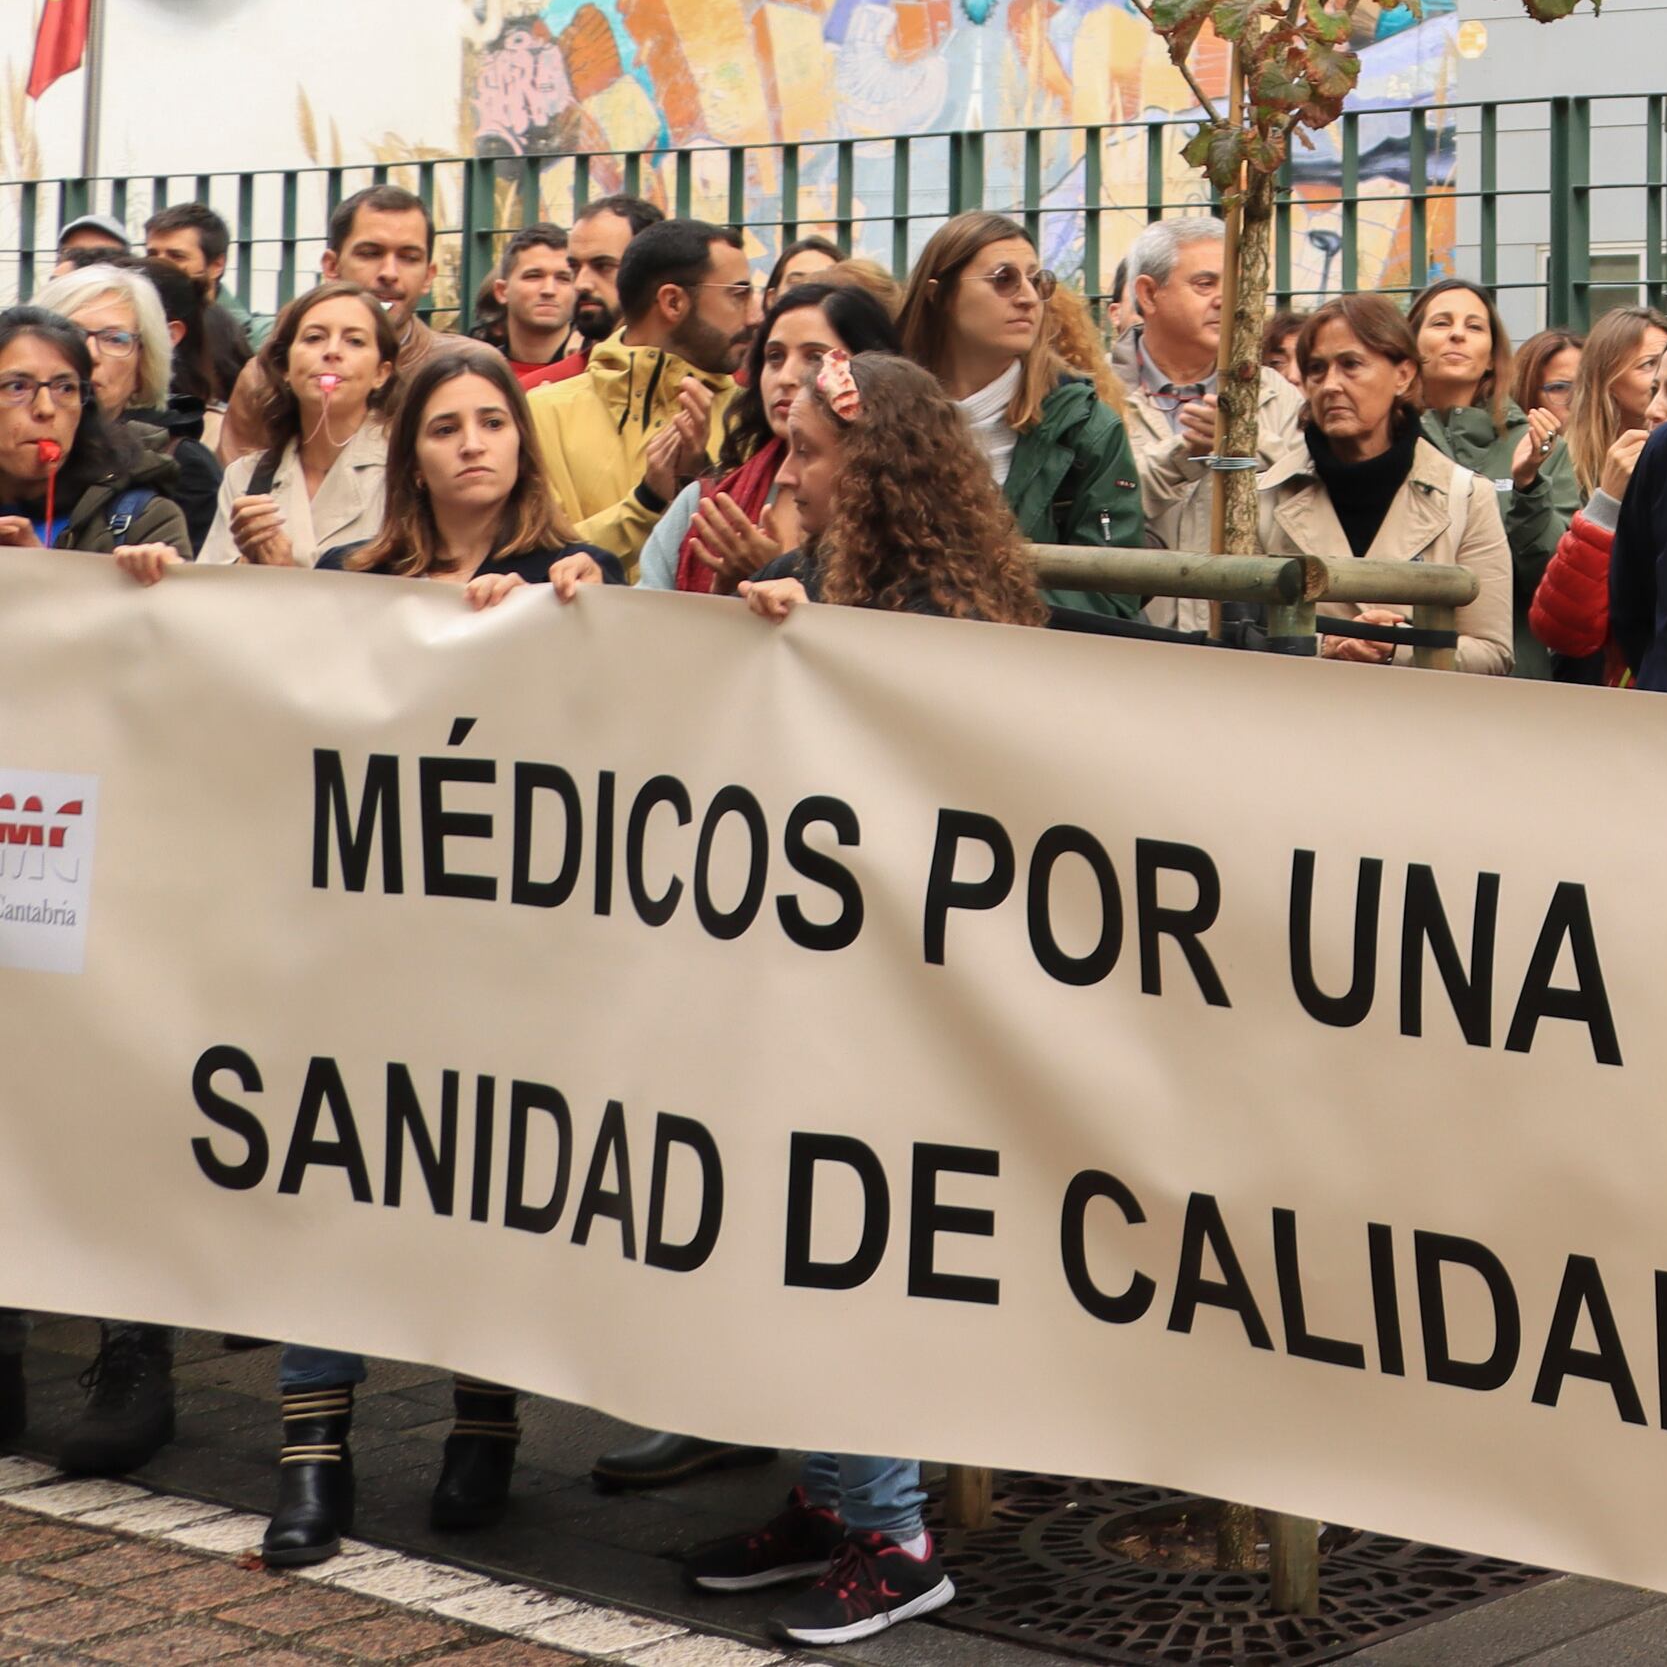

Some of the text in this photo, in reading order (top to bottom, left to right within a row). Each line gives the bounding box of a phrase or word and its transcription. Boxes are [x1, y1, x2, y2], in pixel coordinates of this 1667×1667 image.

[311, 717, 1625, 1067] MÉDICOS POR UNA
[190, 1043, 725, 1274] SANIDAD
[783, 1130, 1001, 1306] DE
